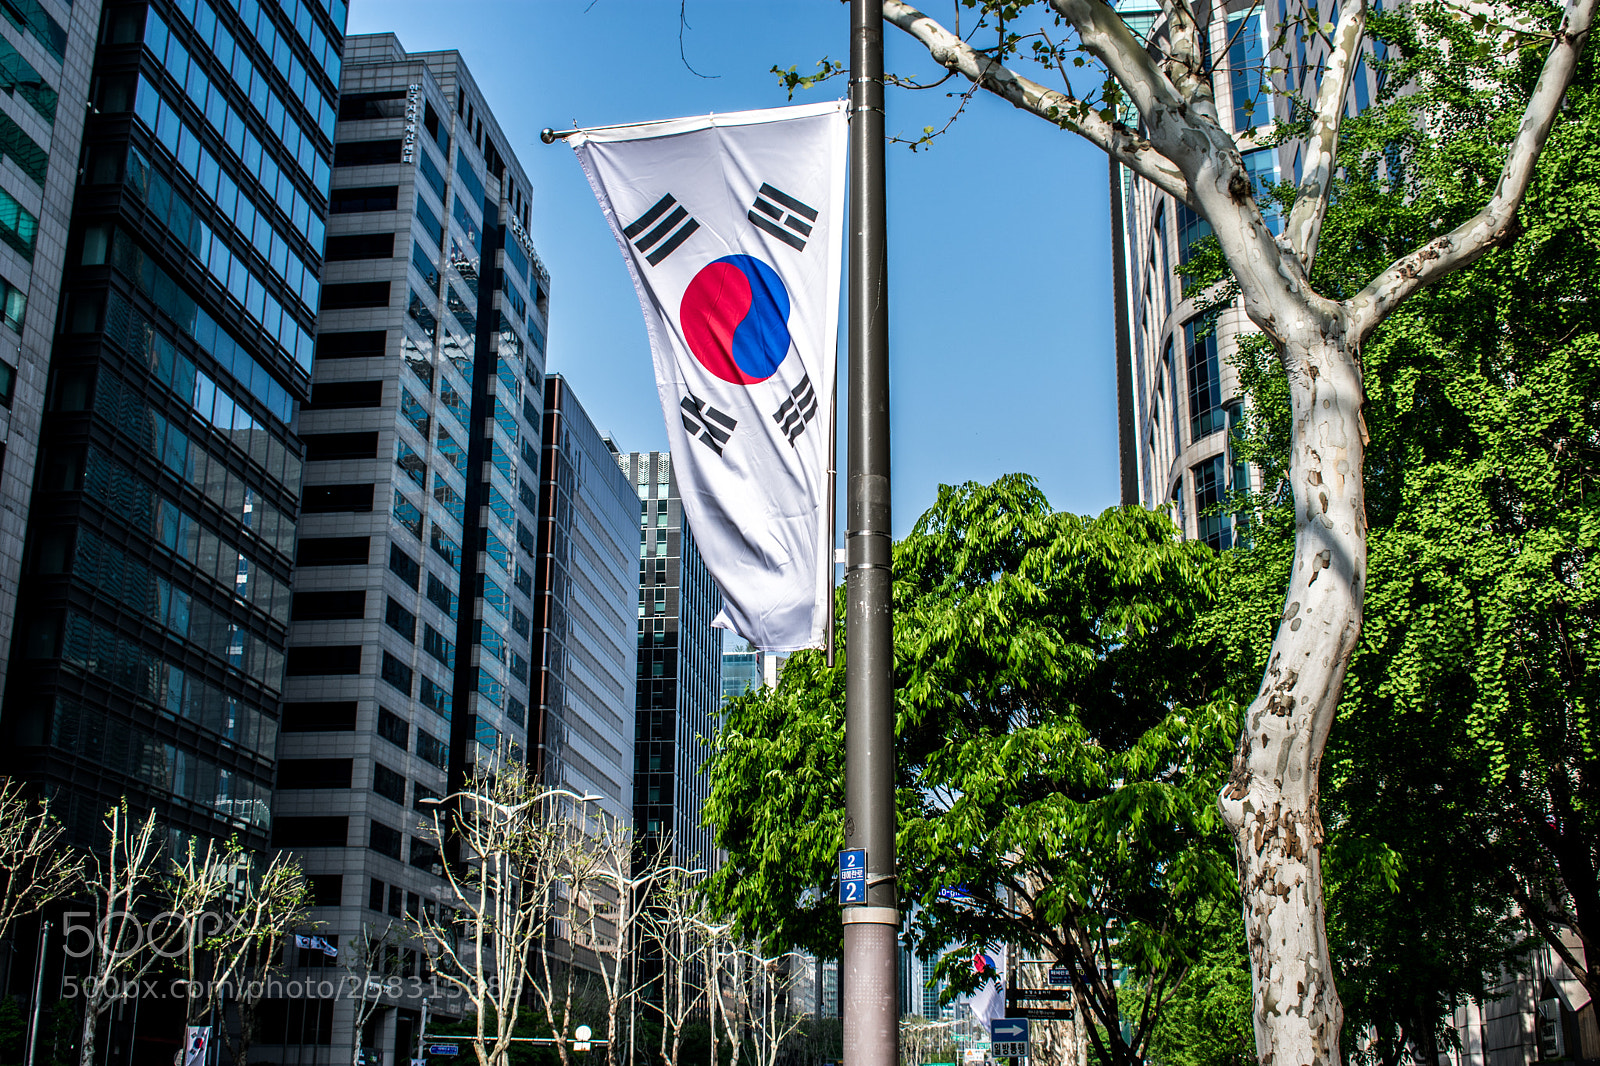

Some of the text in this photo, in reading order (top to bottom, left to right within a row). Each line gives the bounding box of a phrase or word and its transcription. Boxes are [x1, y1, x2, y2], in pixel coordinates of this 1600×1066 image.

[403, 84, 418, 164] 한국지식재산센터
[847, 854, 856, 868] 2
[841, 869, 864, 880] 테헤란로
[846, 882, 857, 902] 2
[994, 1042, 1026, 1056] 일방통행
